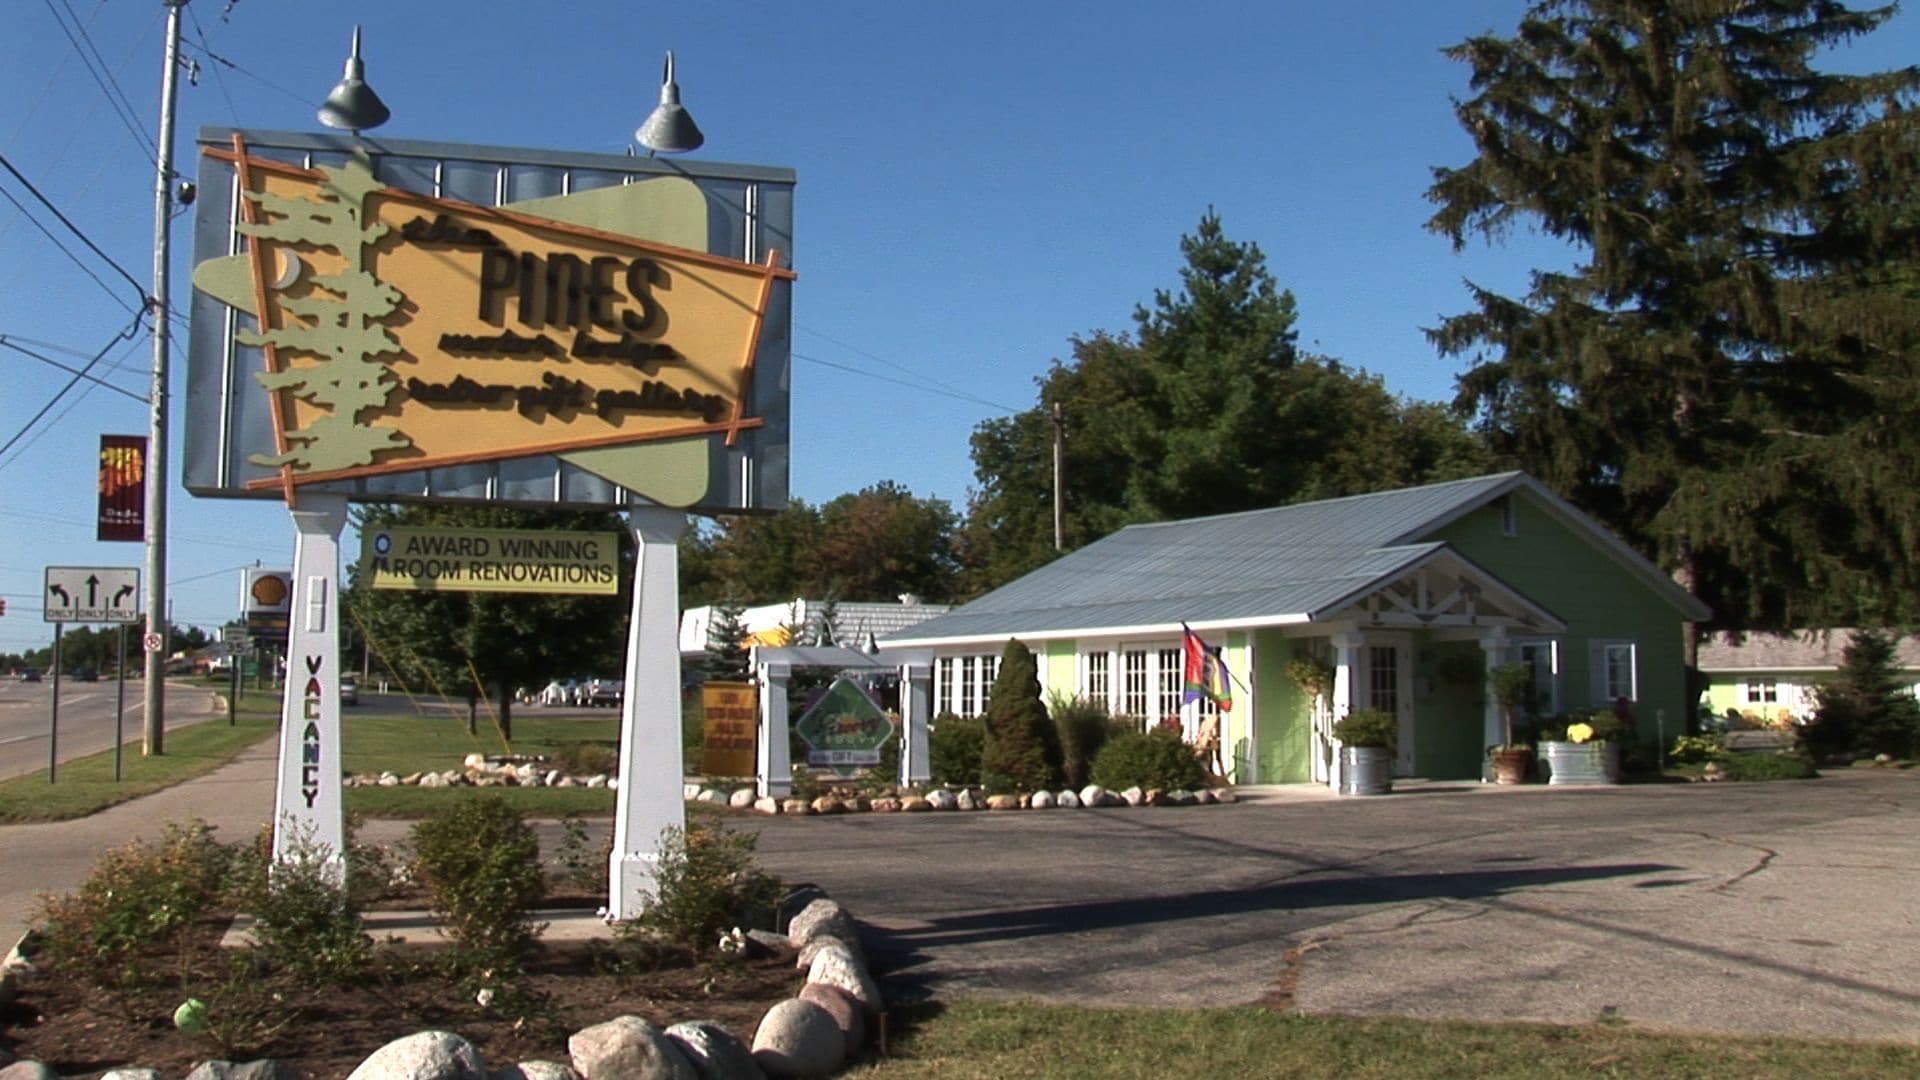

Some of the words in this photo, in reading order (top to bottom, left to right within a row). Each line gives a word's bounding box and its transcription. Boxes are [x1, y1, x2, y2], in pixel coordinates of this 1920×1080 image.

[479, 249, 674, 336] PINES
[406, 536, 489, 556] AWARD
[500, 539, 598, 561] WINNING
[394, 559, 461, 580] ROOM
[469, 561, 613, 583] RENOVATIONS
[47, 608, 74, 617] ONLY
[79, 608, 105, 617] ONLY
[109, 608, 135, 617] ONLY
[302, 655, 322, 808] VACANCY
